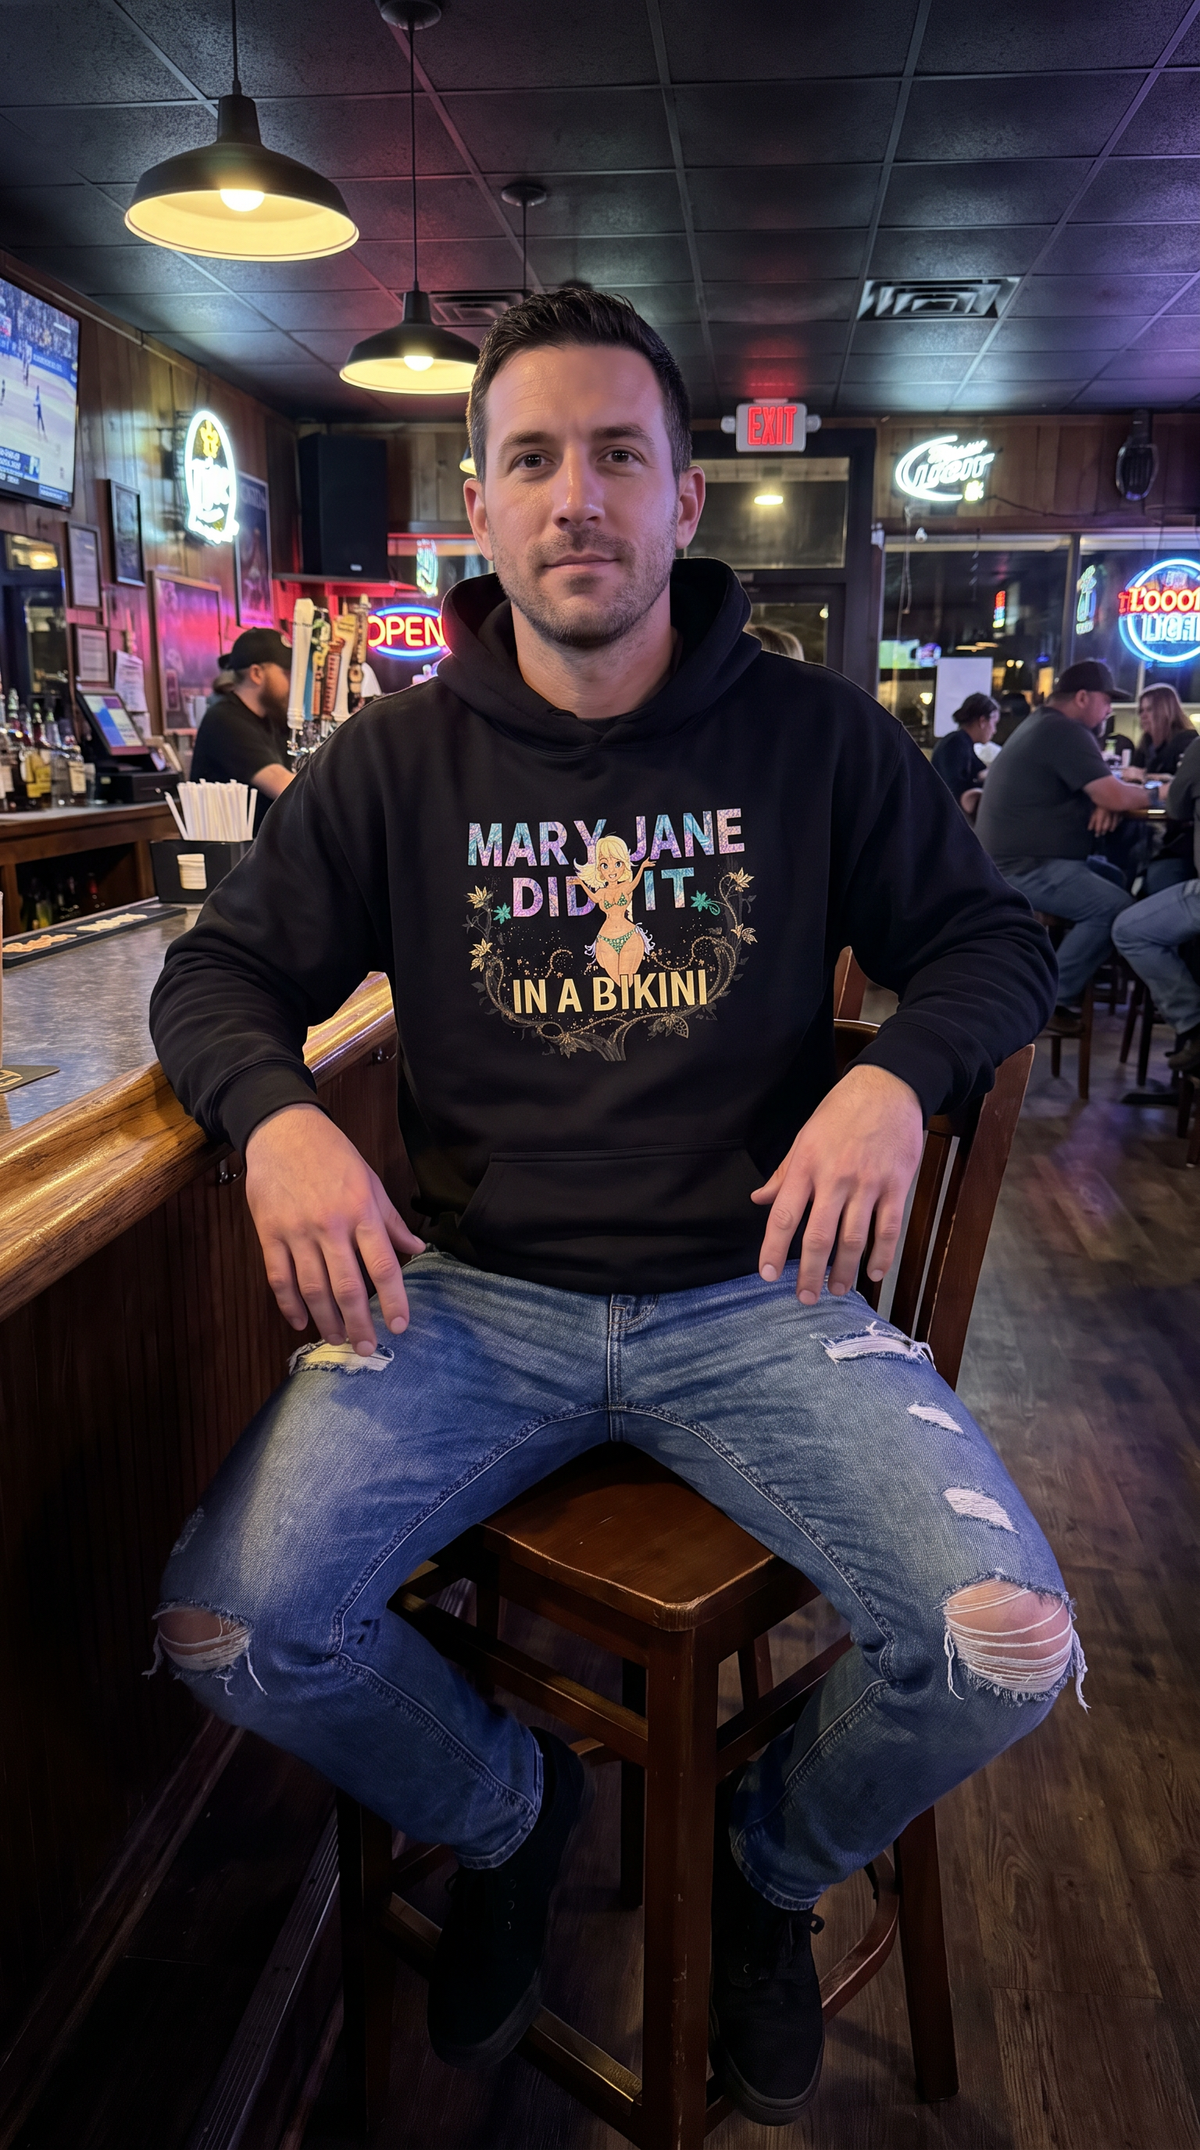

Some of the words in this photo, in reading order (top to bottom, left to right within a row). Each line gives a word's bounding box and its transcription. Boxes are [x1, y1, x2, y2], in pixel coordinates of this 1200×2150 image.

[748, 406, 797, 445] EXIT
[367, 615, 446, 647] OPEN
[468, 818, 607, 867] MARY
[629, 808, 745, 862] JANE
[512, 875, 597, 918] DID
[643, 867, 695, 911] IT
[513, 979, 547, 1014] IN
[557, 978, 583, 1013] A
[592, 969, 708, 1012] BIKINI
